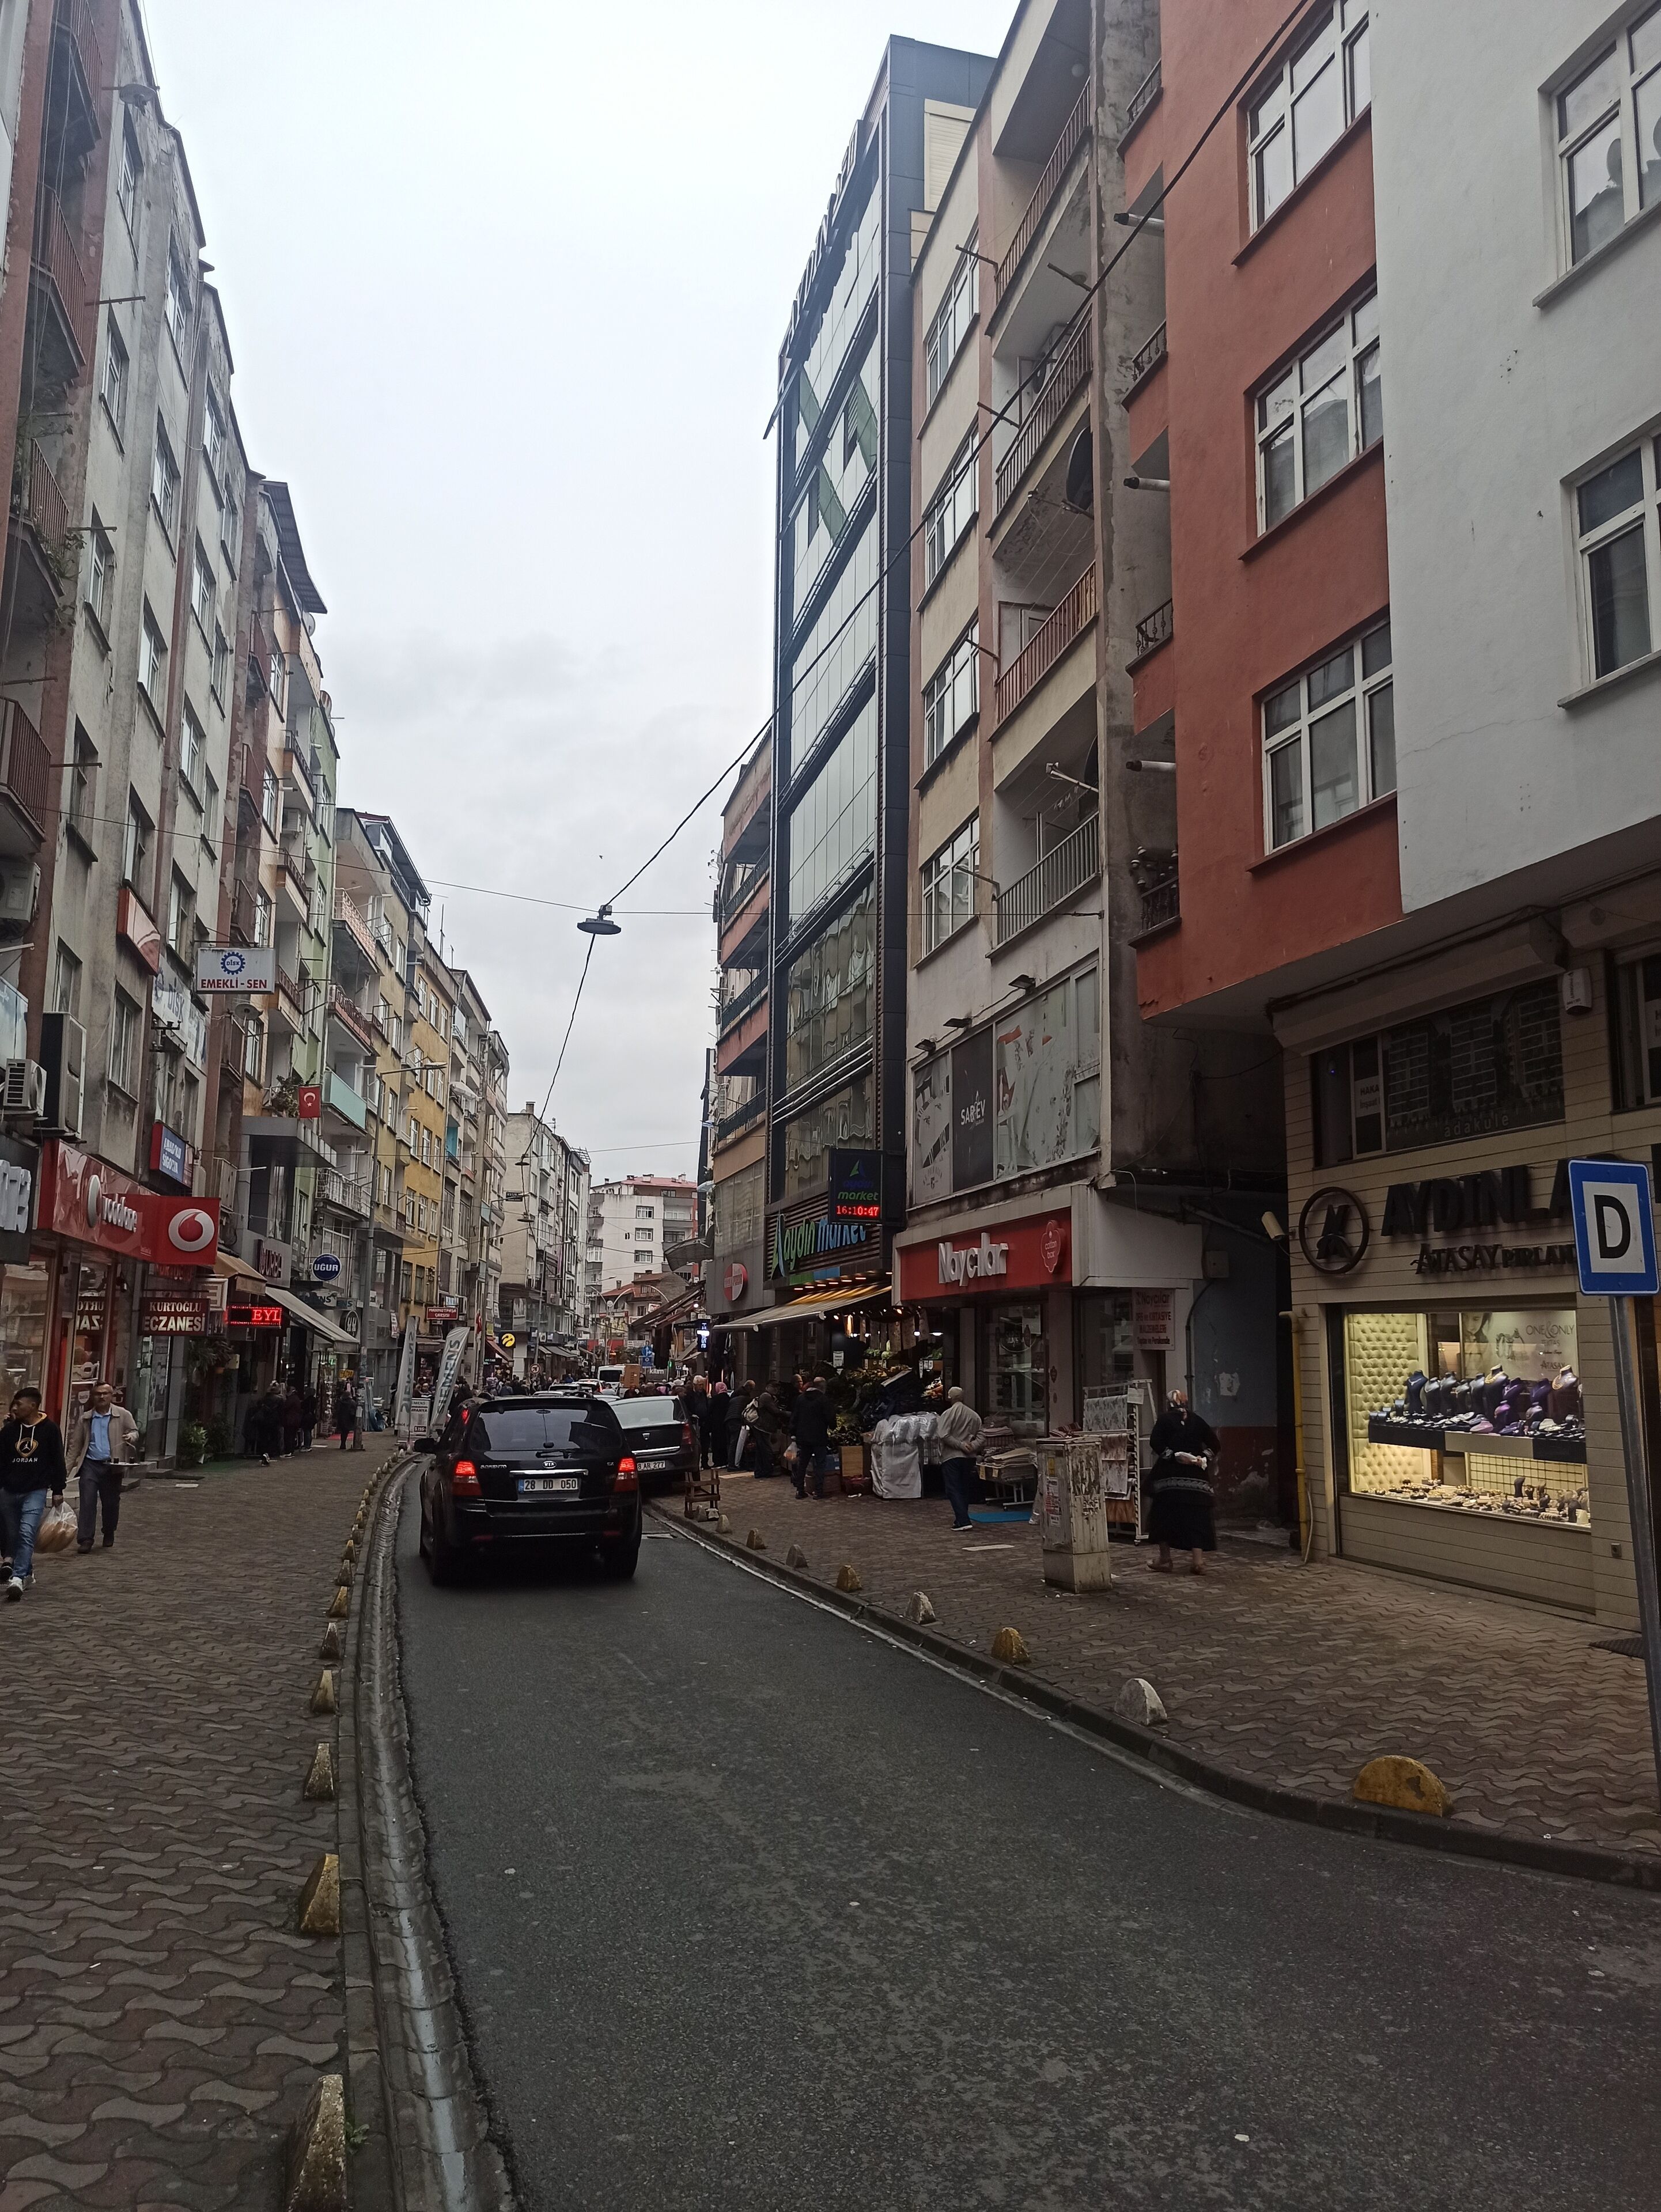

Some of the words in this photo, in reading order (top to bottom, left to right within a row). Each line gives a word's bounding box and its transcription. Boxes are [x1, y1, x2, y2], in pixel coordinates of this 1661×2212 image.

[201, 977, 239, 988] EMEKLİ
[247, 979, 267, 988] SEN
[1444, 1115, 1509, 1138] adakule
[838, 1191, 879, 1201] market
[836, 1205, 880, 1217] 16:10:47
[1594, 1195, 1631, 1259] D
[1047, 1251, 1055, 1259] box
[1410, 1244, 1503, 1275] ATASAY
[315, 1262, 339, 1272] UĞUR
[150, 1301, 202, 1313] KURTOĞLU
[143, 1313, 205, 1332] ECZANESİ
[525, 1480, 535, 1490] 28
[543, 1480, 553, 1490] DD
[561, 1479, 577, 1489] 050
